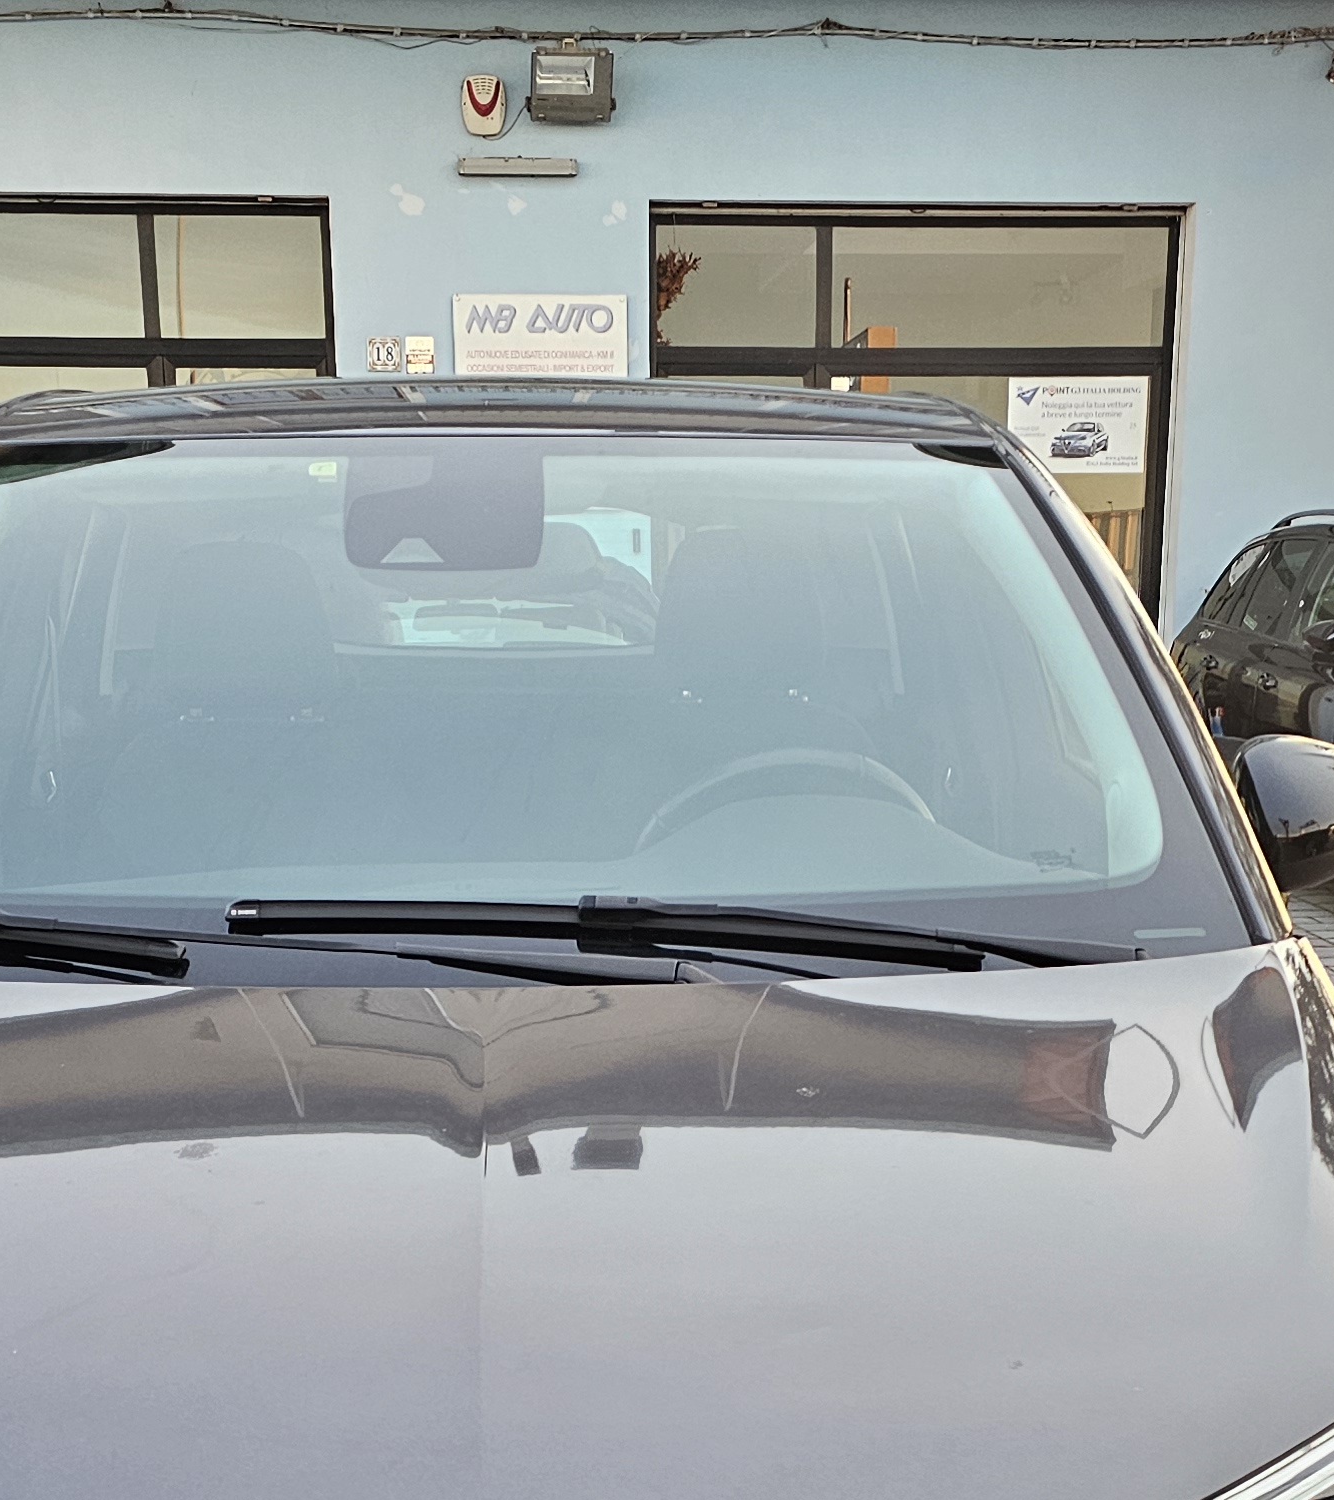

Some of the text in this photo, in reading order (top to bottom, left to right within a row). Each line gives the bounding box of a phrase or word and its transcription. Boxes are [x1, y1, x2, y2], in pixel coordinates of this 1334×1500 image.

[466, 303, 614, 334] MB AUTO
[375, 346, 394, 362] 18
[466, 350, 485, 359] AUTO
[487, 350, 509, 359] NUOVE
[521, 350, 542, 359] USATE
[569, 350, 593, 359] MARCA
[597, 350, 608, 359] KM
[467, 364, 505, 373] OCCASIONI
[506, 364, 549, 373] SEMESTRALI
[553, 364, 579, 373] IMPORT
[587, 364, 614, 373] EXPORT
[1042, 385, 1070, 397] POINT
[1041, 401, 1072, 410] Noleggia
[1107, 401, 1133, 409] vettura
[1047, 410, 1067, 418] breve
[1074, 410, 1094, 419] lungo
